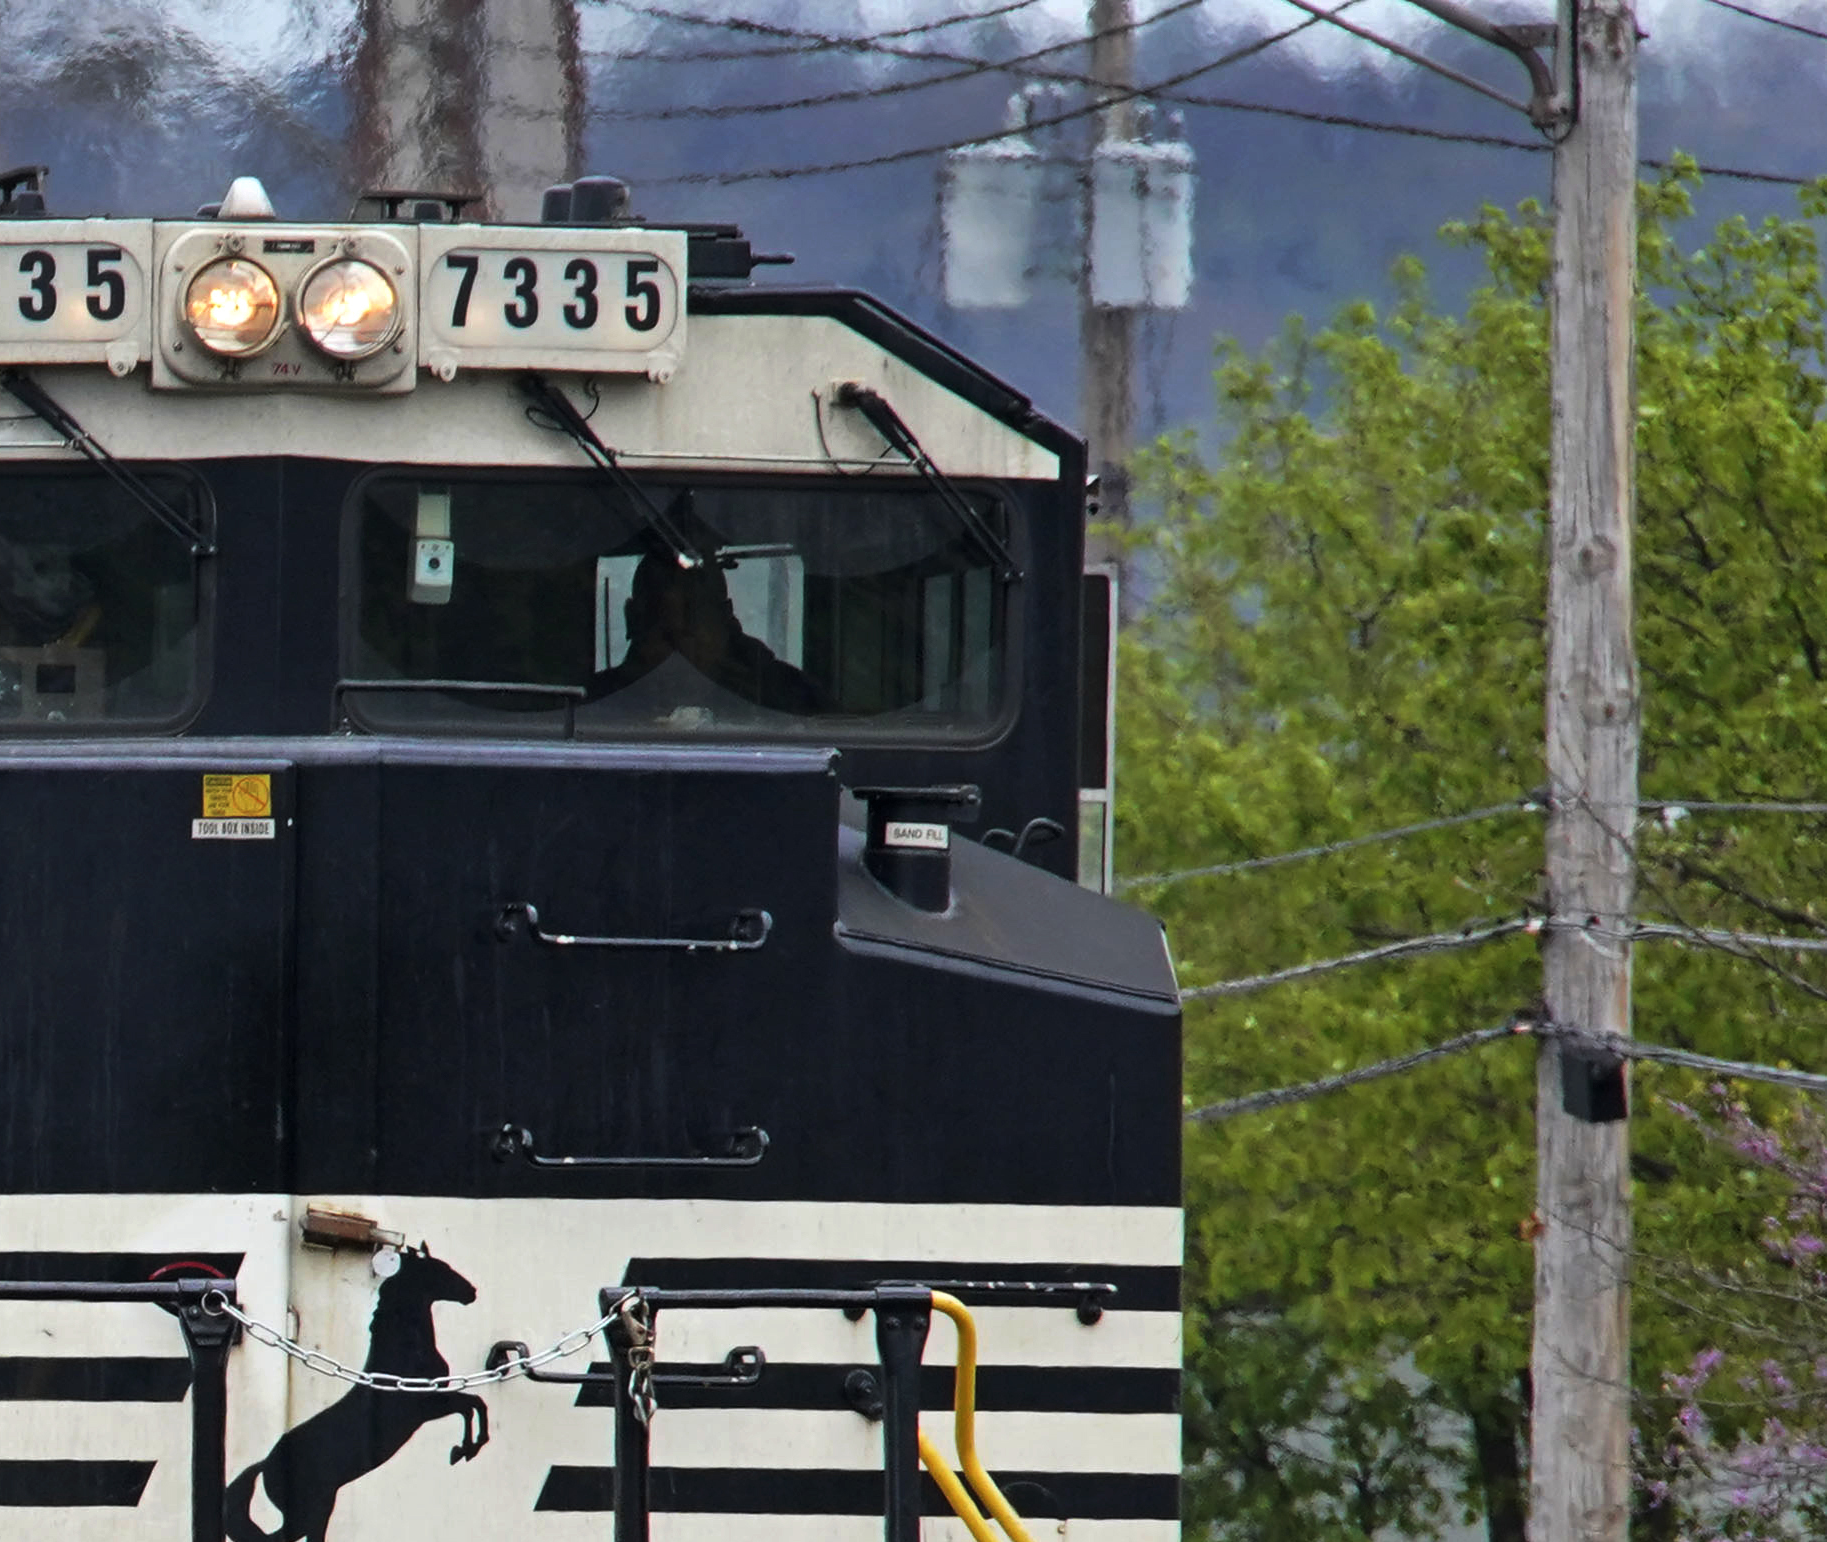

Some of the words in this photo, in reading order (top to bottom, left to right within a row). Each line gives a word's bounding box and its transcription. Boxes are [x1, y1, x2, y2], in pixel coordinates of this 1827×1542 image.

[446, 254, 661, 332] 7335
[198, 821, 219, 835] TOOL
[222, 821, 239, 835] BOX
[240, 821, 270, 835] INSIDE
[893, 827, 922, 840] SAND
[925, 828, 943, 841] FILL
